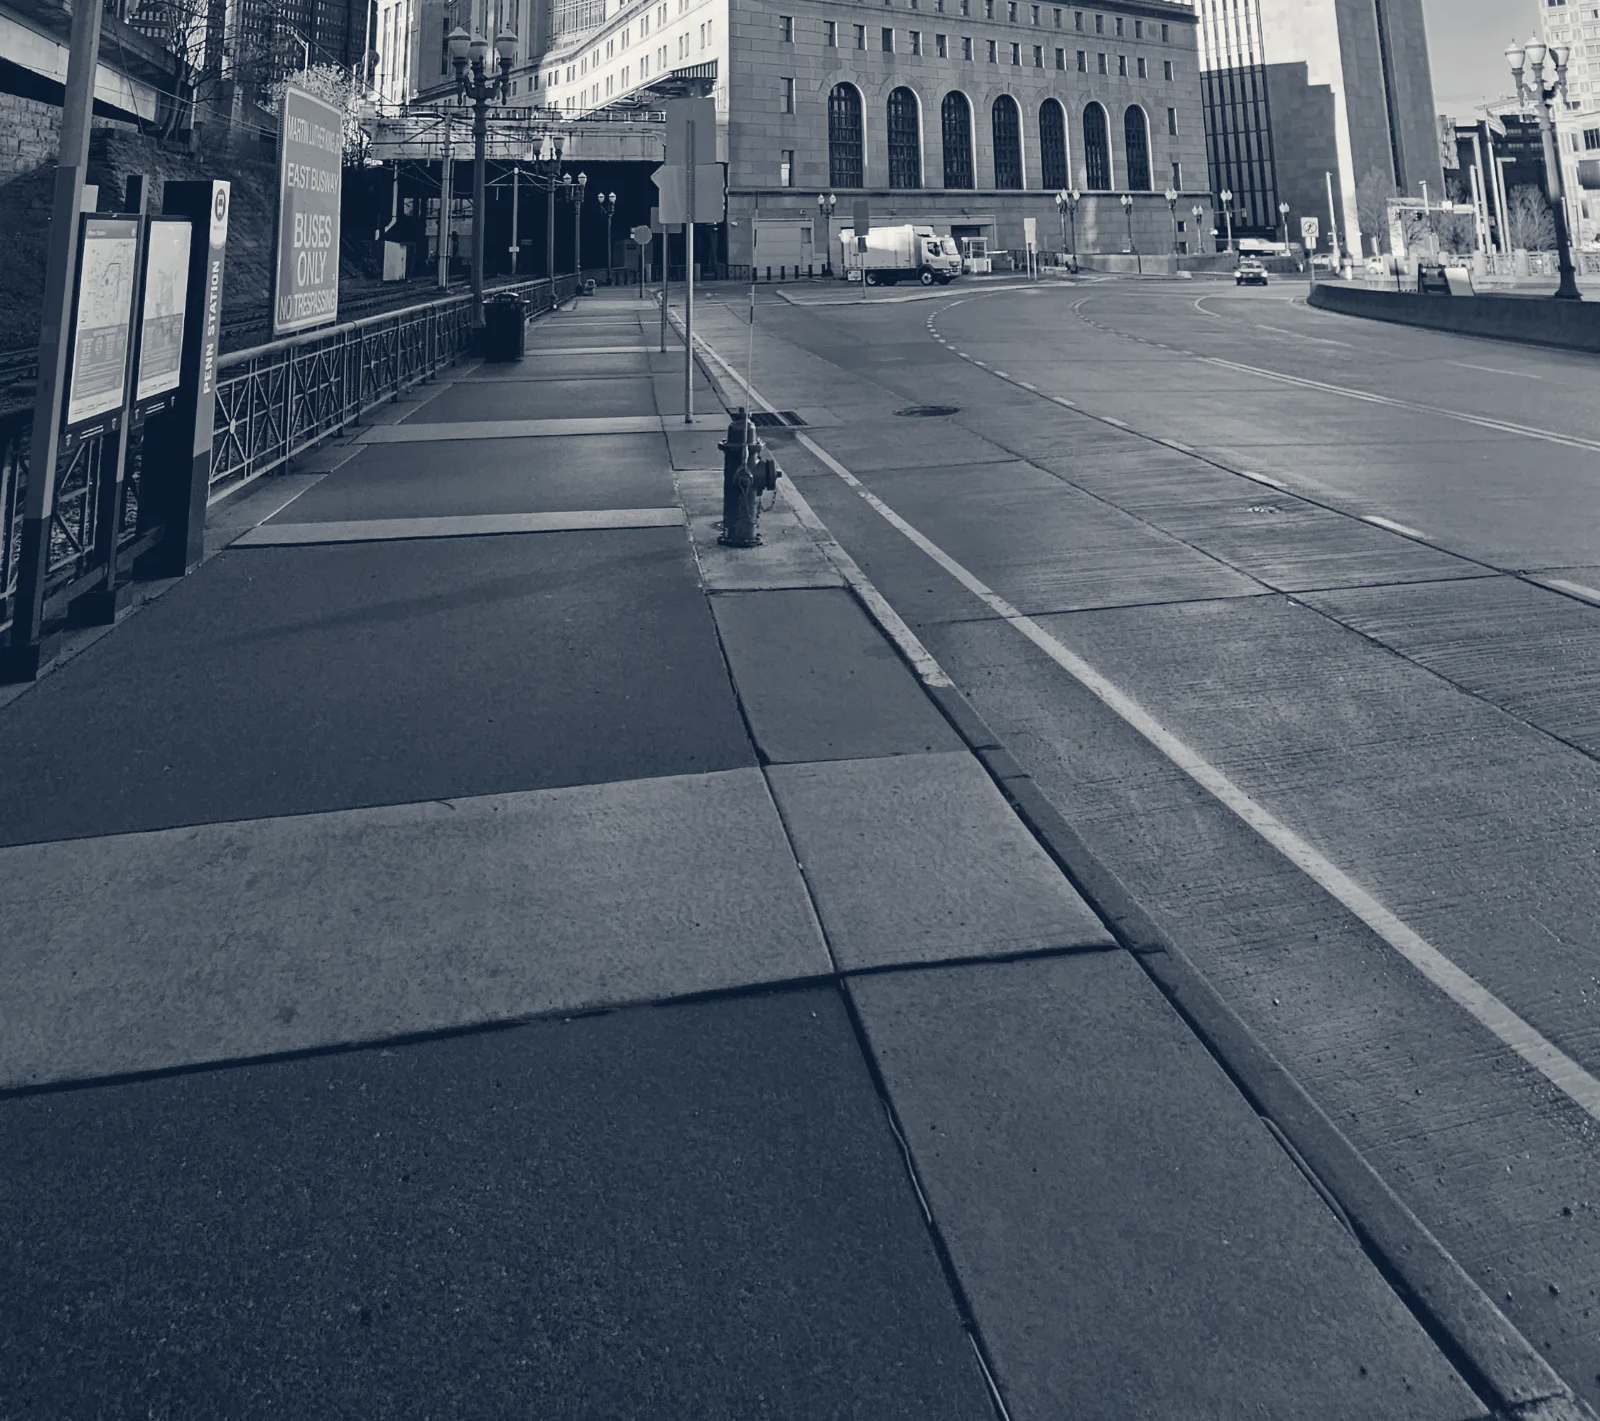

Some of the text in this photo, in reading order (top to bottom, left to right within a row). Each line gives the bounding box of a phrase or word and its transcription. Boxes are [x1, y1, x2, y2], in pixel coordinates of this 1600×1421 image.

[287, 115, 308, 144] MARTIN
[287, 162, 339, 194] EAST BUSWAY
[293, 212, 332, 249] BUSES
[297, 251, 327, 287] ONLY
[279, 289, 336, 321] NO TRESPASSING
[203, 260, 220, 395] PENN STATION
